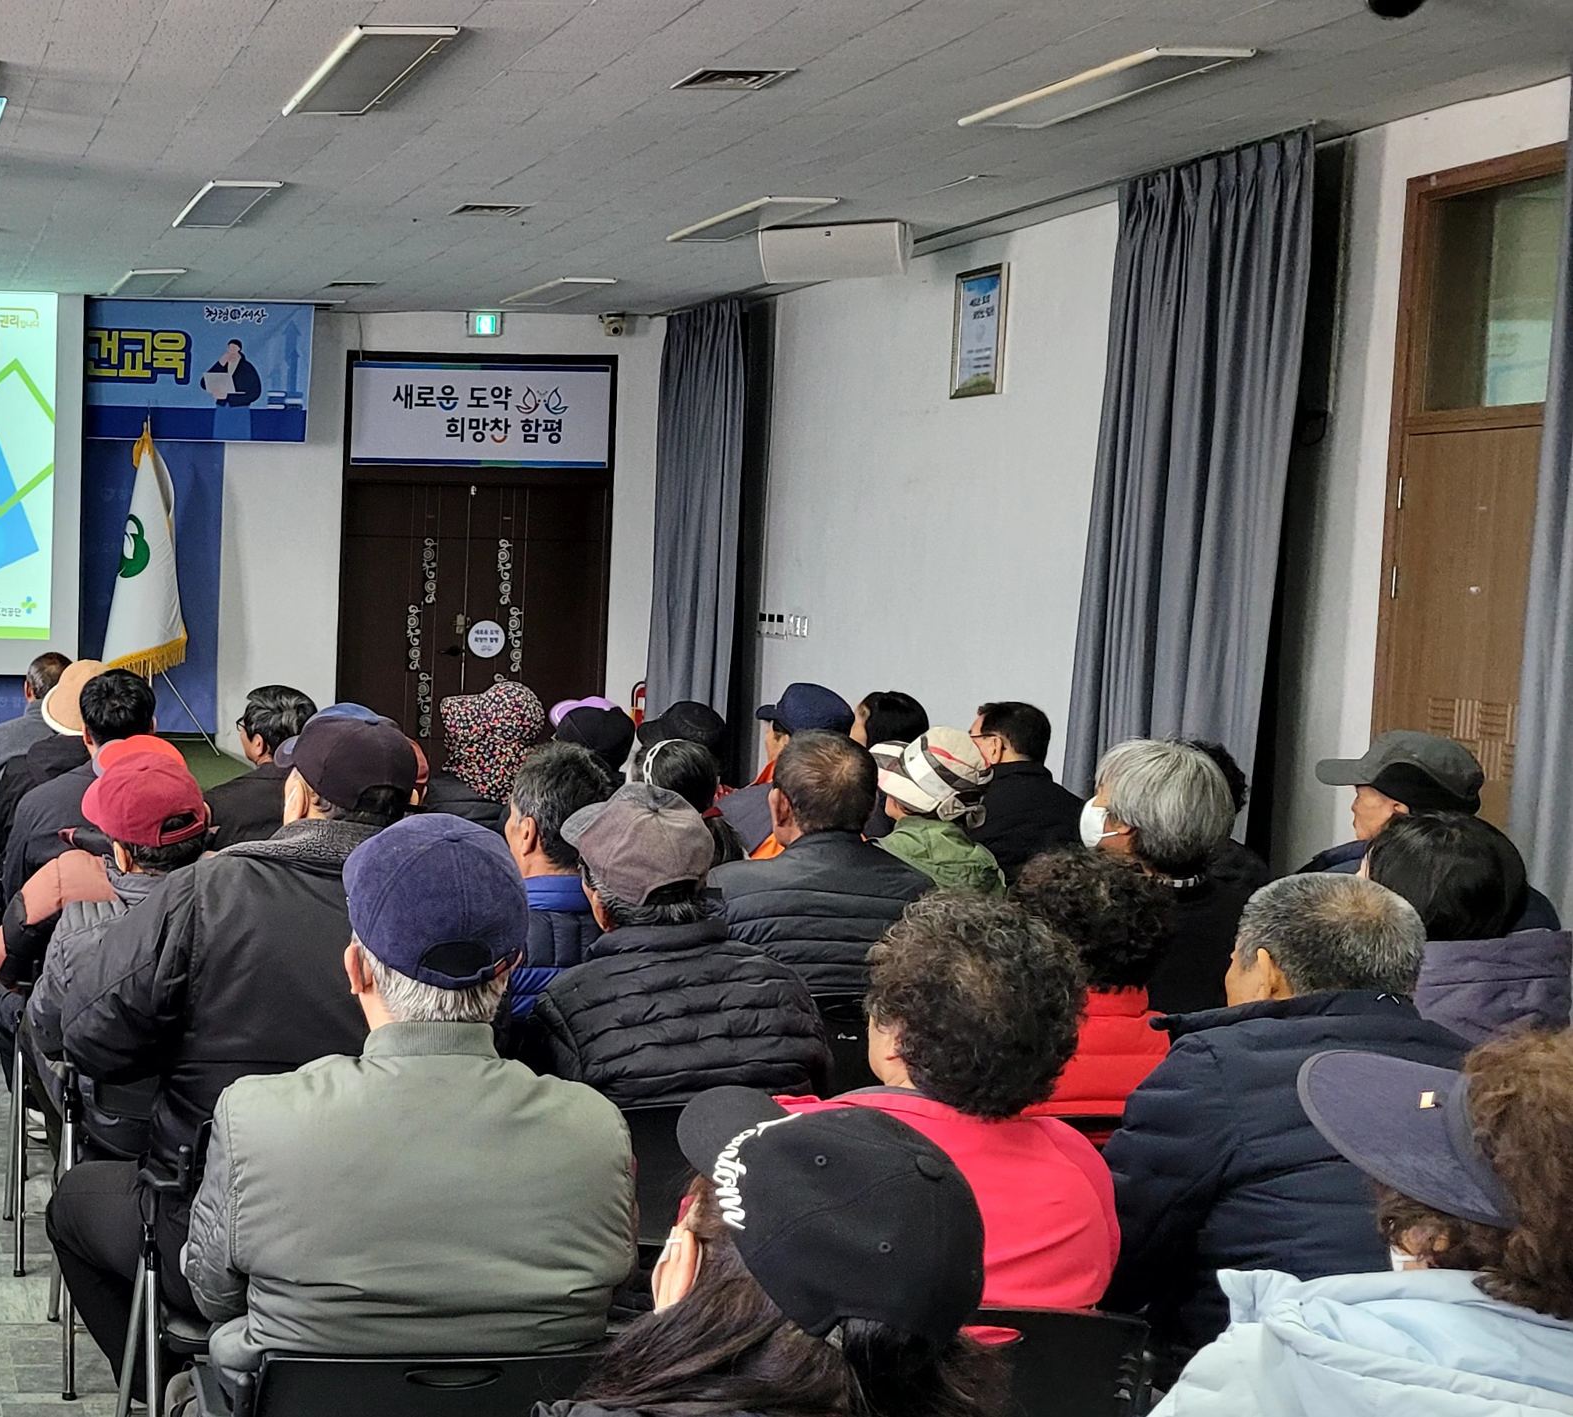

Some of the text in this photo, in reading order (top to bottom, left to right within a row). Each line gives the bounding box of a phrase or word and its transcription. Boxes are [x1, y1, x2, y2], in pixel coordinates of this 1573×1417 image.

[392, 384, 513, 411] 새로운 도약
[445, 416, 563, 445] 희망찬 함평
